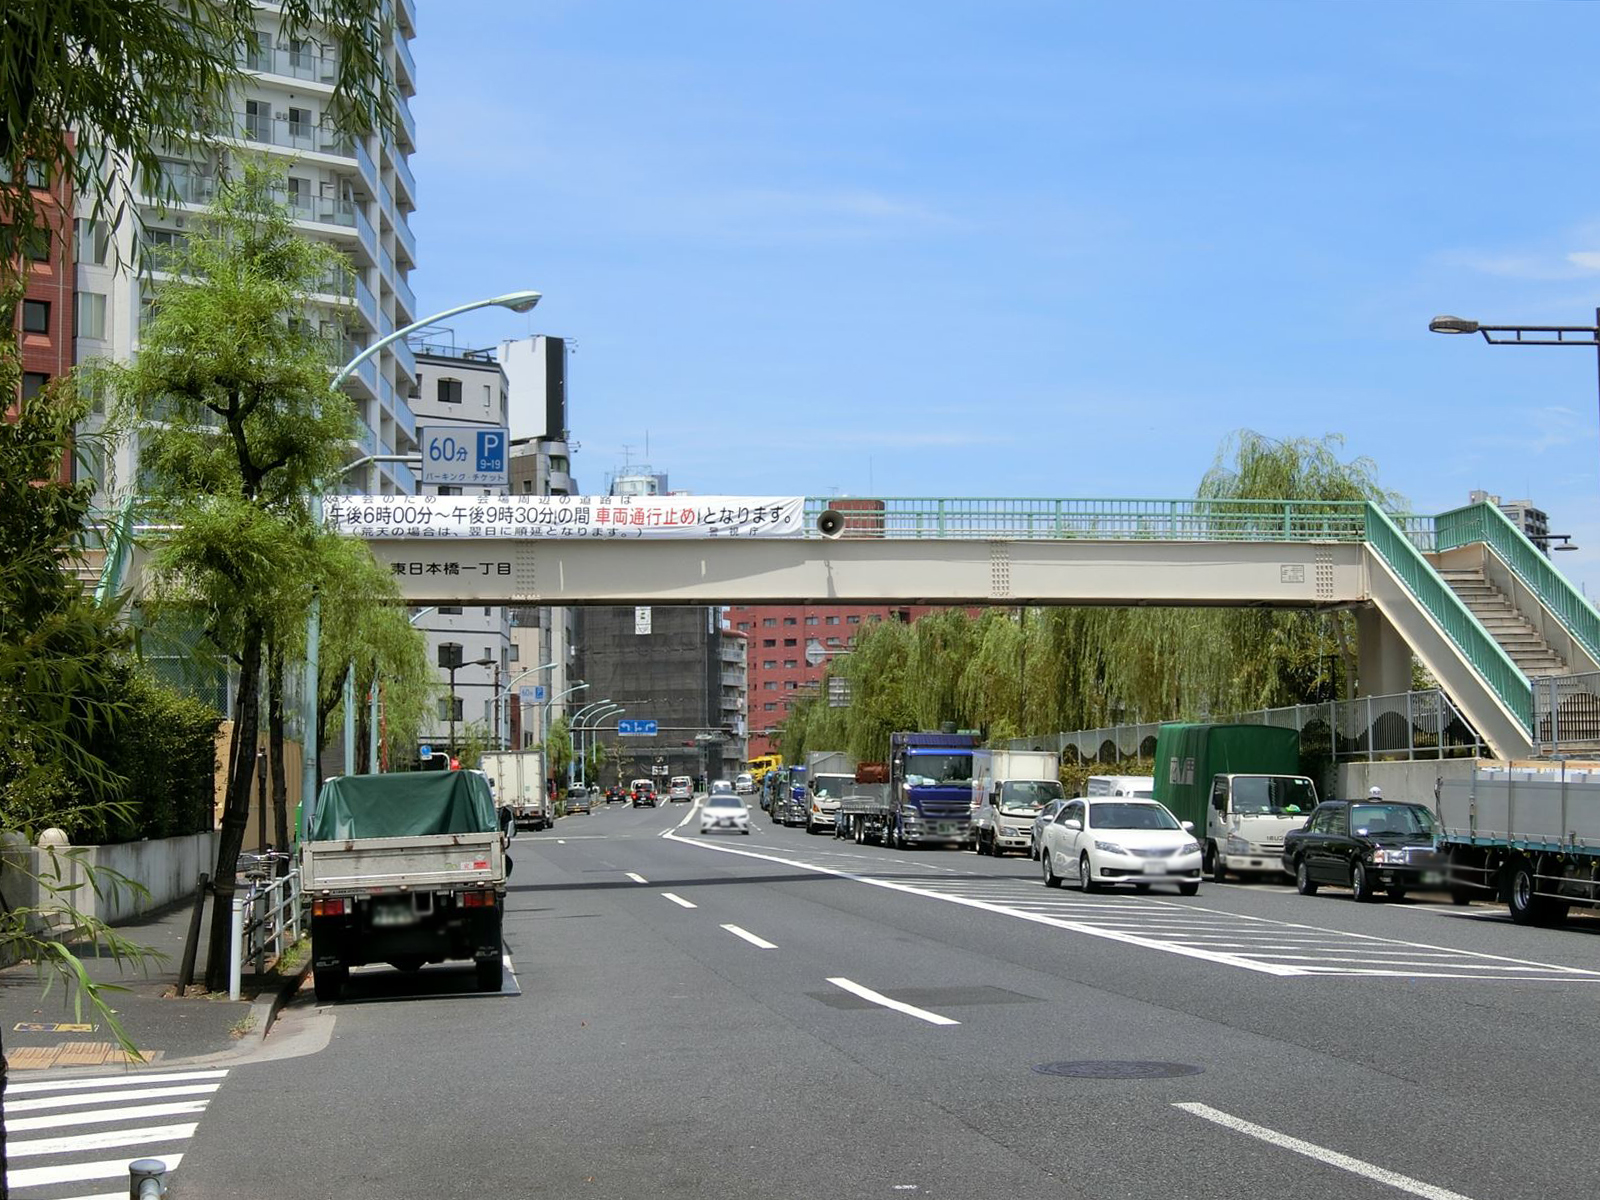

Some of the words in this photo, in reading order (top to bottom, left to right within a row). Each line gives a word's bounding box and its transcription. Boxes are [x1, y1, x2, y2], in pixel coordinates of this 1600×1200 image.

[429, 437, 468, 462] 60分
[484, 434, 499, 457] P
[480, 459, 501, 470] 9-19
[391, 562, 511, 575] 東日本橋一丁目
